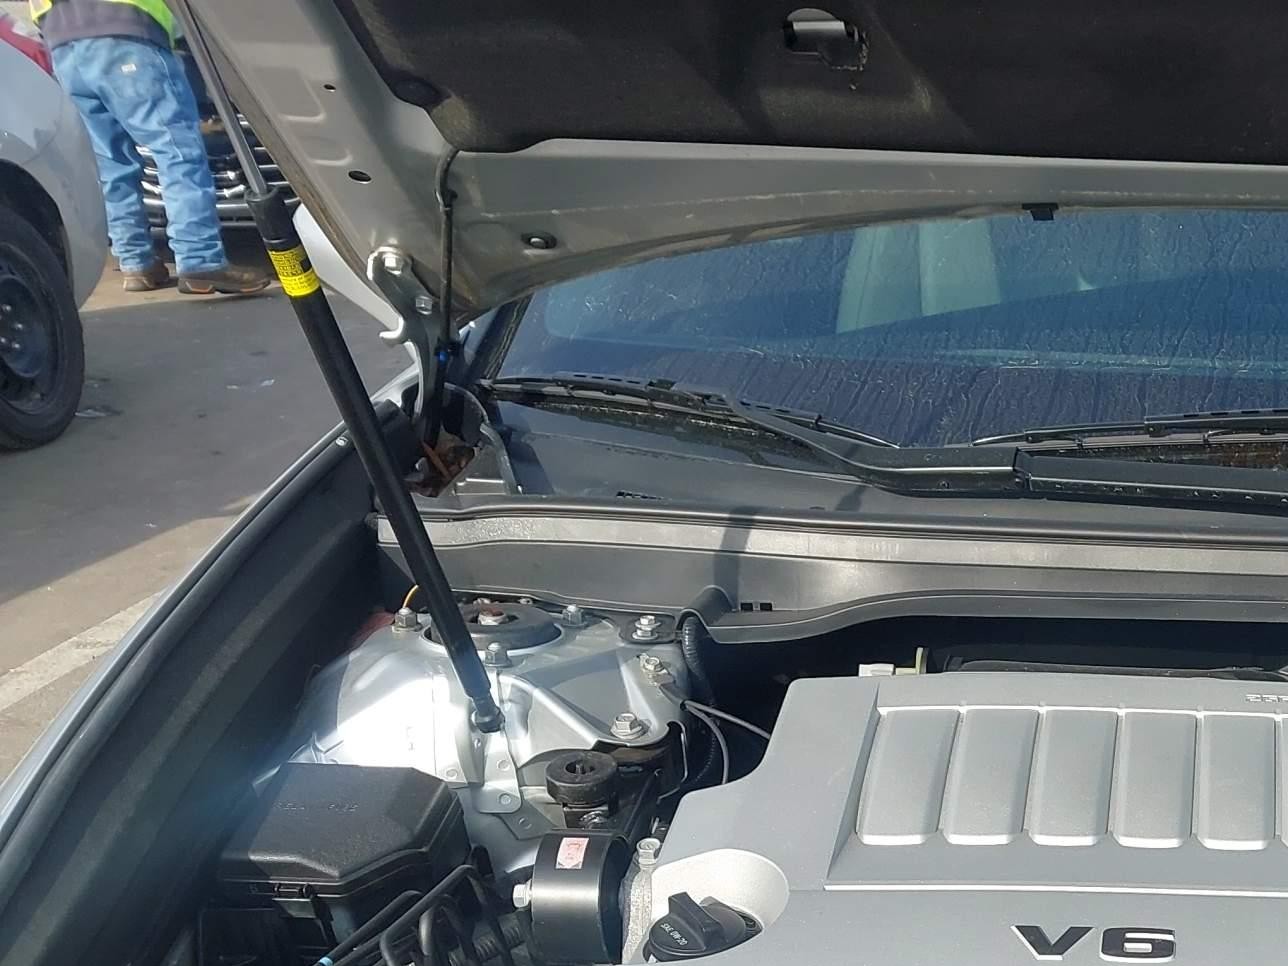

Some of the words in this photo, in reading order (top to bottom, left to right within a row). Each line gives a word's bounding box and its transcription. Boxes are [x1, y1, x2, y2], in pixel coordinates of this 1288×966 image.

[660, 923, 674, 933] SAE
[670, 931, 688, 945] 0W-20
[1011, 924, 1177, 963] V6
